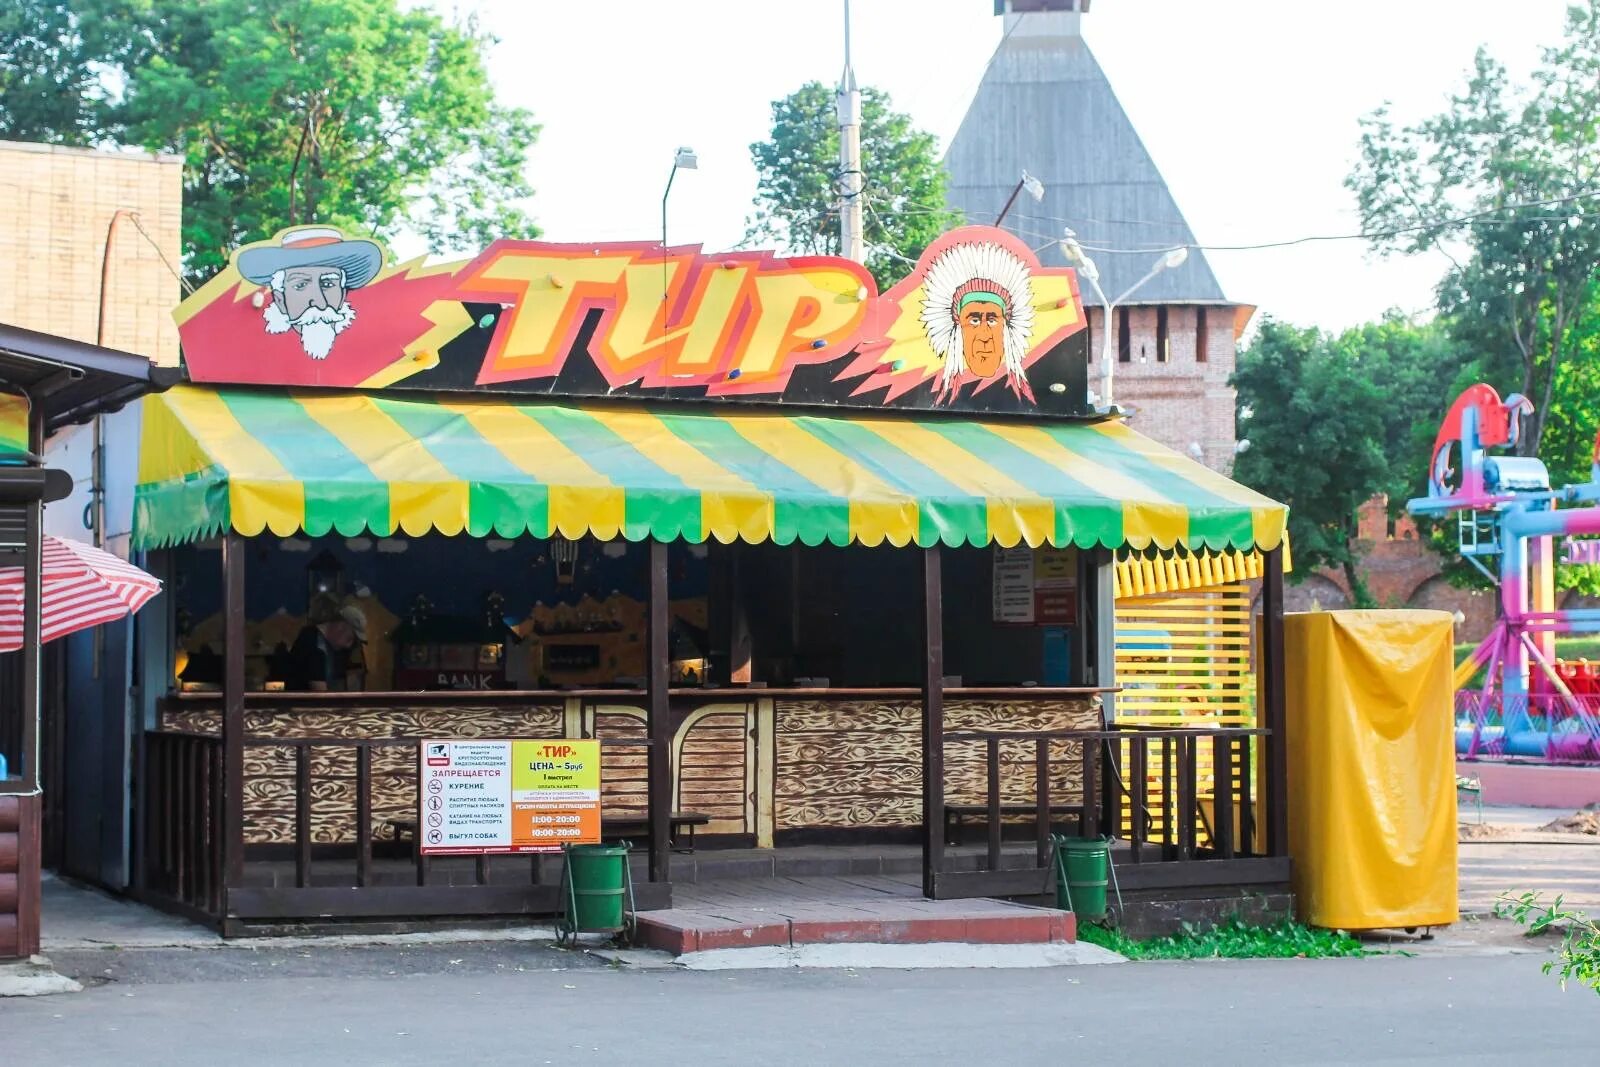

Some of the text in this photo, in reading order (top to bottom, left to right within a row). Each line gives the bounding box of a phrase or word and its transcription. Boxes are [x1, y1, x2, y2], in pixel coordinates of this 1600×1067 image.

[466, 252, 869, 380] ТИР
[437, 674, 493, 690] BANK
[537, 745, 577, 758] «ТИР»
[529, 762, 554, 771] ЦЕНА
[432, 769, 501, 778] ЗАПРЕЩАЕТСЯ
[531, 828, 581, 837] 10:00-20:00
